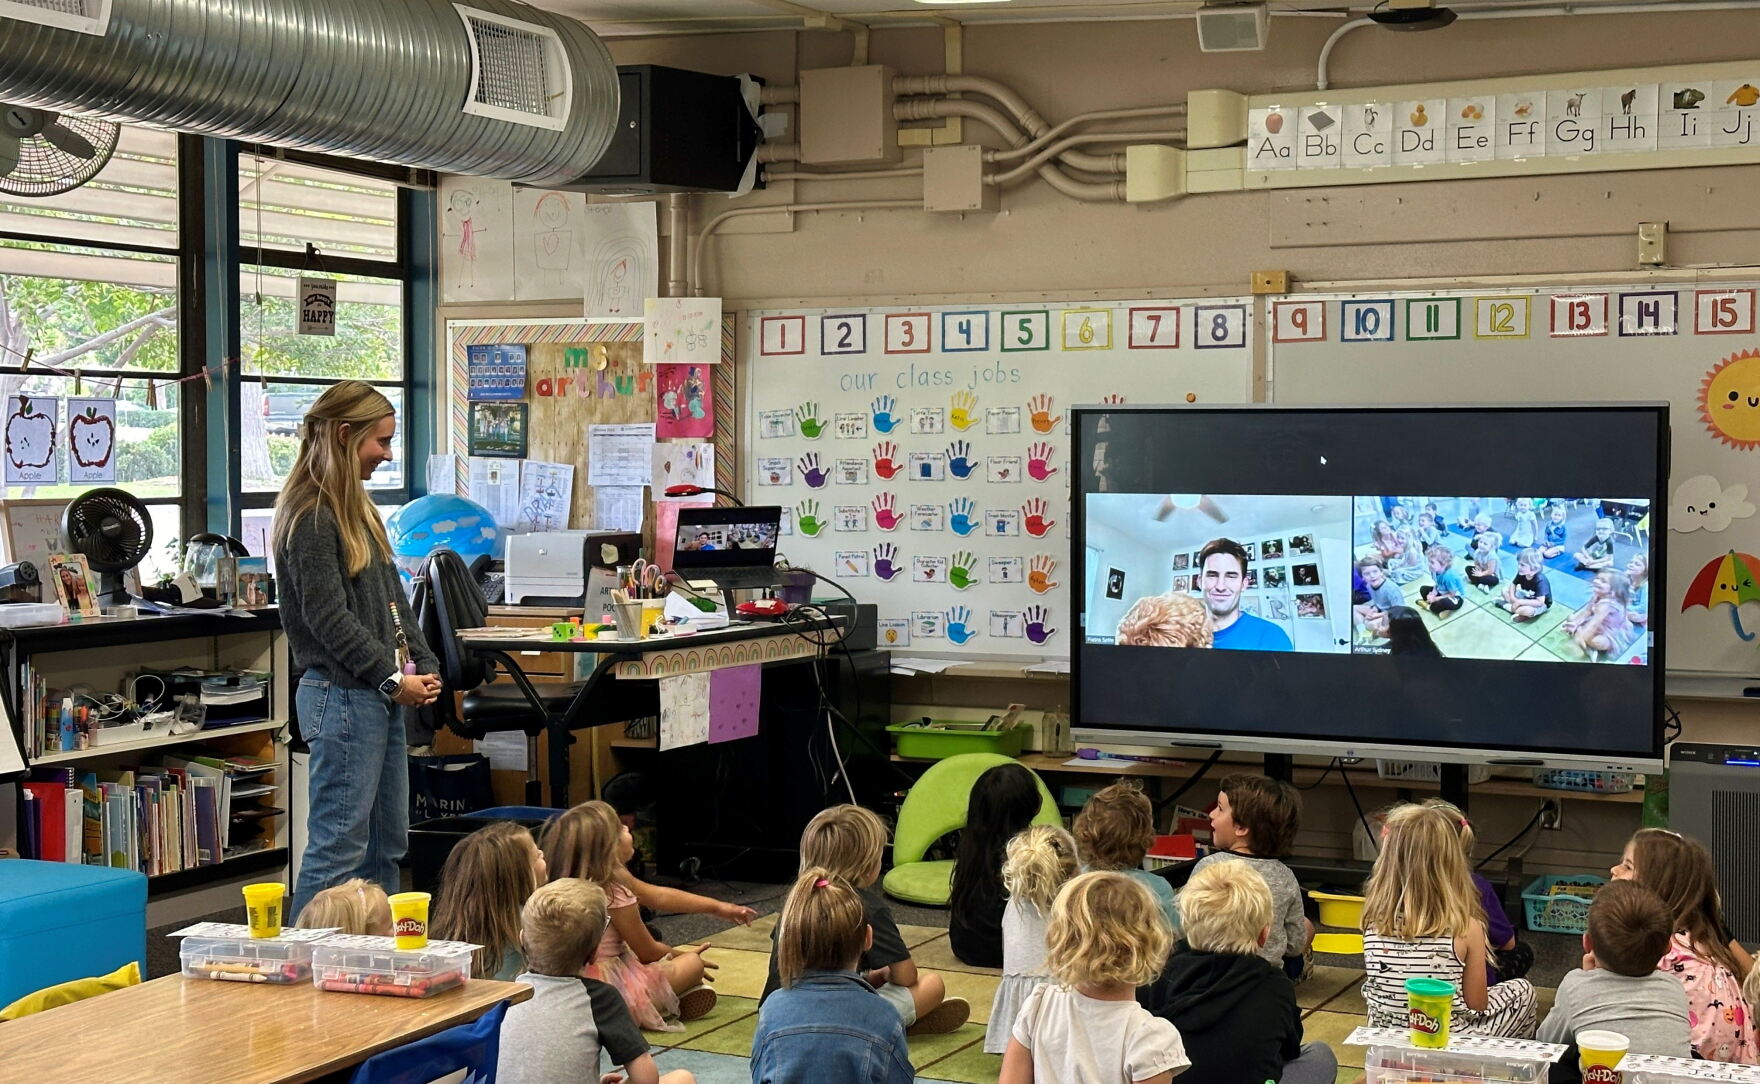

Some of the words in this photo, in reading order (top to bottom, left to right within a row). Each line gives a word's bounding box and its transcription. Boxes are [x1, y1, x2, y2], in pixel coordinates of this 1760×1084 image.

[1255, 136, 1291, 159] Aa
[1305, 134, 1337, 157] Bb
[1353, 132, 1384, 155] Cc
[1401, 128, 1434, 152] Dd
[1457, 126, 1489, 149] Ee
[1508, 121, 1540, 145] Ff
[1555, 119, 1595, 151] Gg
[1610, 115, 1646, 140] Hh
[1680, 112, 1697, 136] Ii
[1722, 110, 1751, 144] Jj
[303, 309, 334, 324] HAPPY
[780, 323, 786, 349] 1
[836, 321, 852, 348] 2
[901, 320, 915, 347] 3
[958, 318, 971, 345] 4
[1016, 317, 1033, 345] 5
[1079, 316, 1094, 344] 6
[1146, 314, 1162, 343] 7
[1211, 313, 1229, 342] 8
[1291, 310, 1308, 336] 9
[1354, 308, 1380, 336] 10
[1426, 304, 1439, 333] 11
[1489, 303, 1515, 332] 12
[1569, 301, 1592, 330] 13
[1636, 299, 1660, 329] 14
[1711, 298, 1738, 327] 15
[535, 367, 653, 399] arthur
[840, 371, 879, 392] our
[896, 363, 954, 389] class
[968, 361, 1021, 390] jobs
[19, 471, 42, 480] Apple
[83, 471, 103, 479] Apple
[1372, 647, 1392, 655] Sydney
